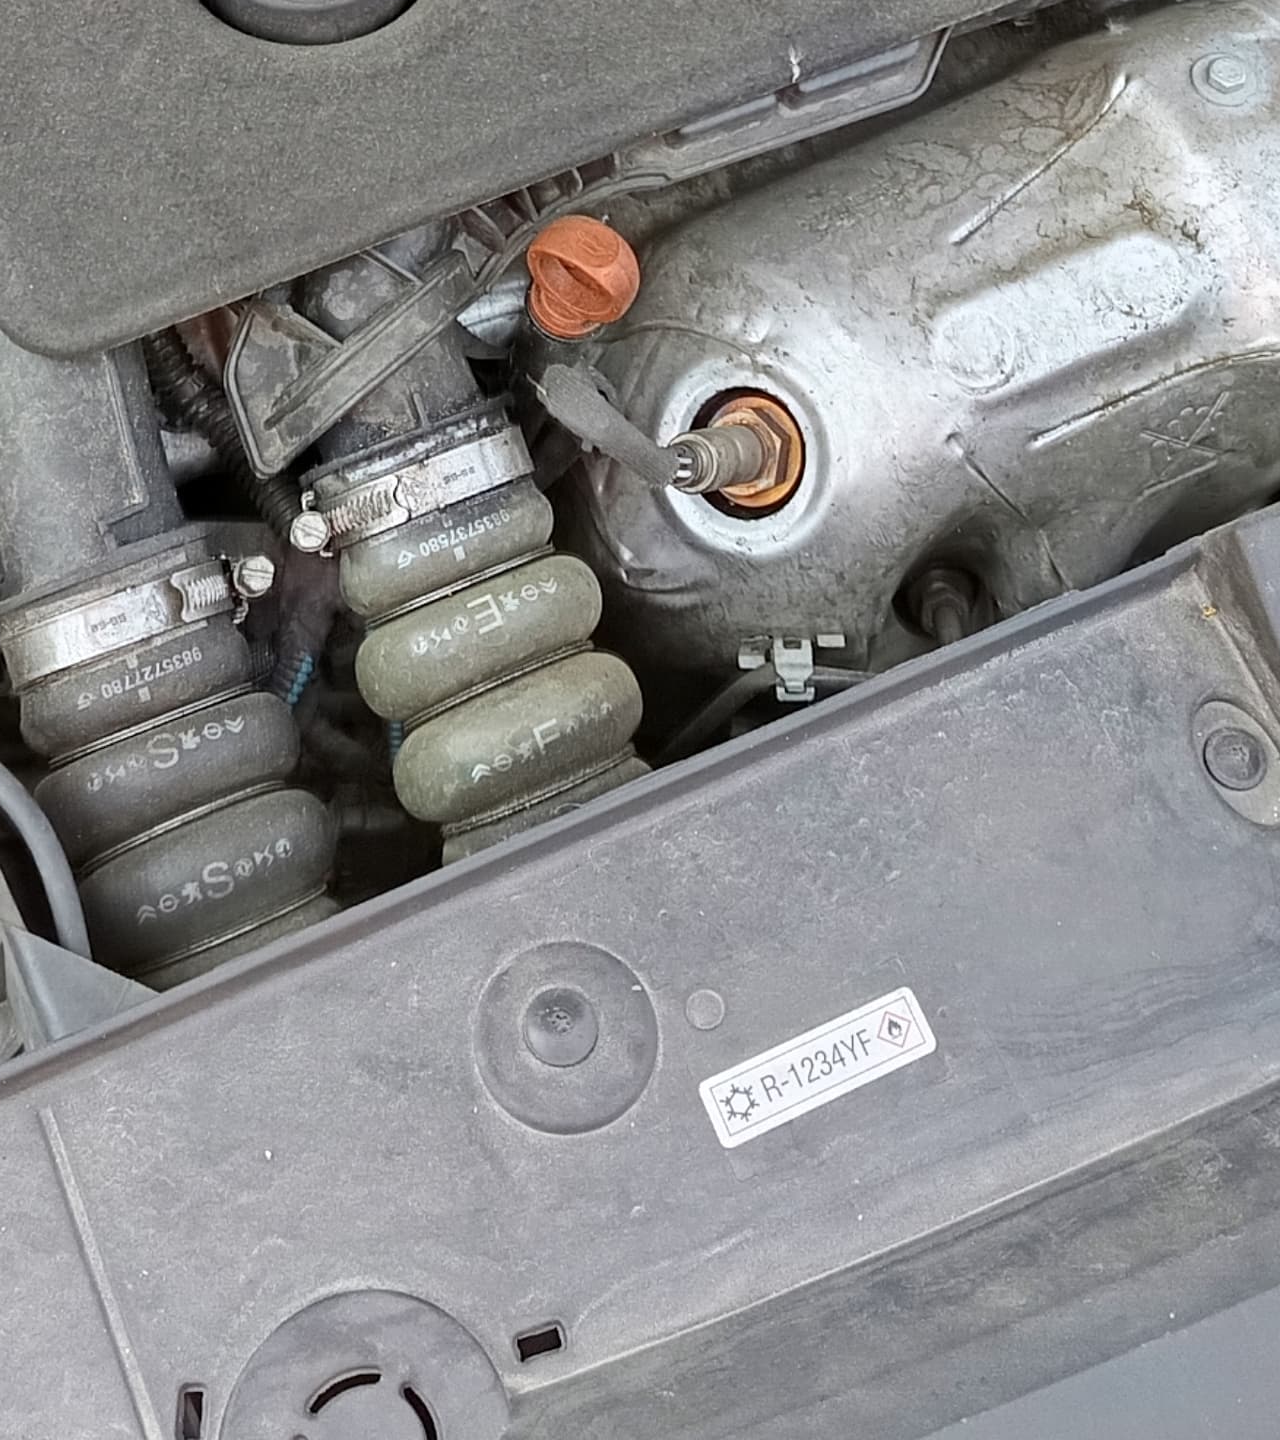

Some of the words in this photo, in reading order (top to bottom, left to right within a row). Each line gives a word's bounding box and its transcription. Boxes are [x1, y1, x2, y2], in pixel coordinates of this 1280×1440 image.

[419, 509, 511, 557] 9835737580
[467, 593, 505, 635] E
[101, 646, 203, 699] 9835727780
[147, 733, 179, 769] S
[202, 861, 235, 899] S
[760, 1028, 872, 1103] R-1234YF
